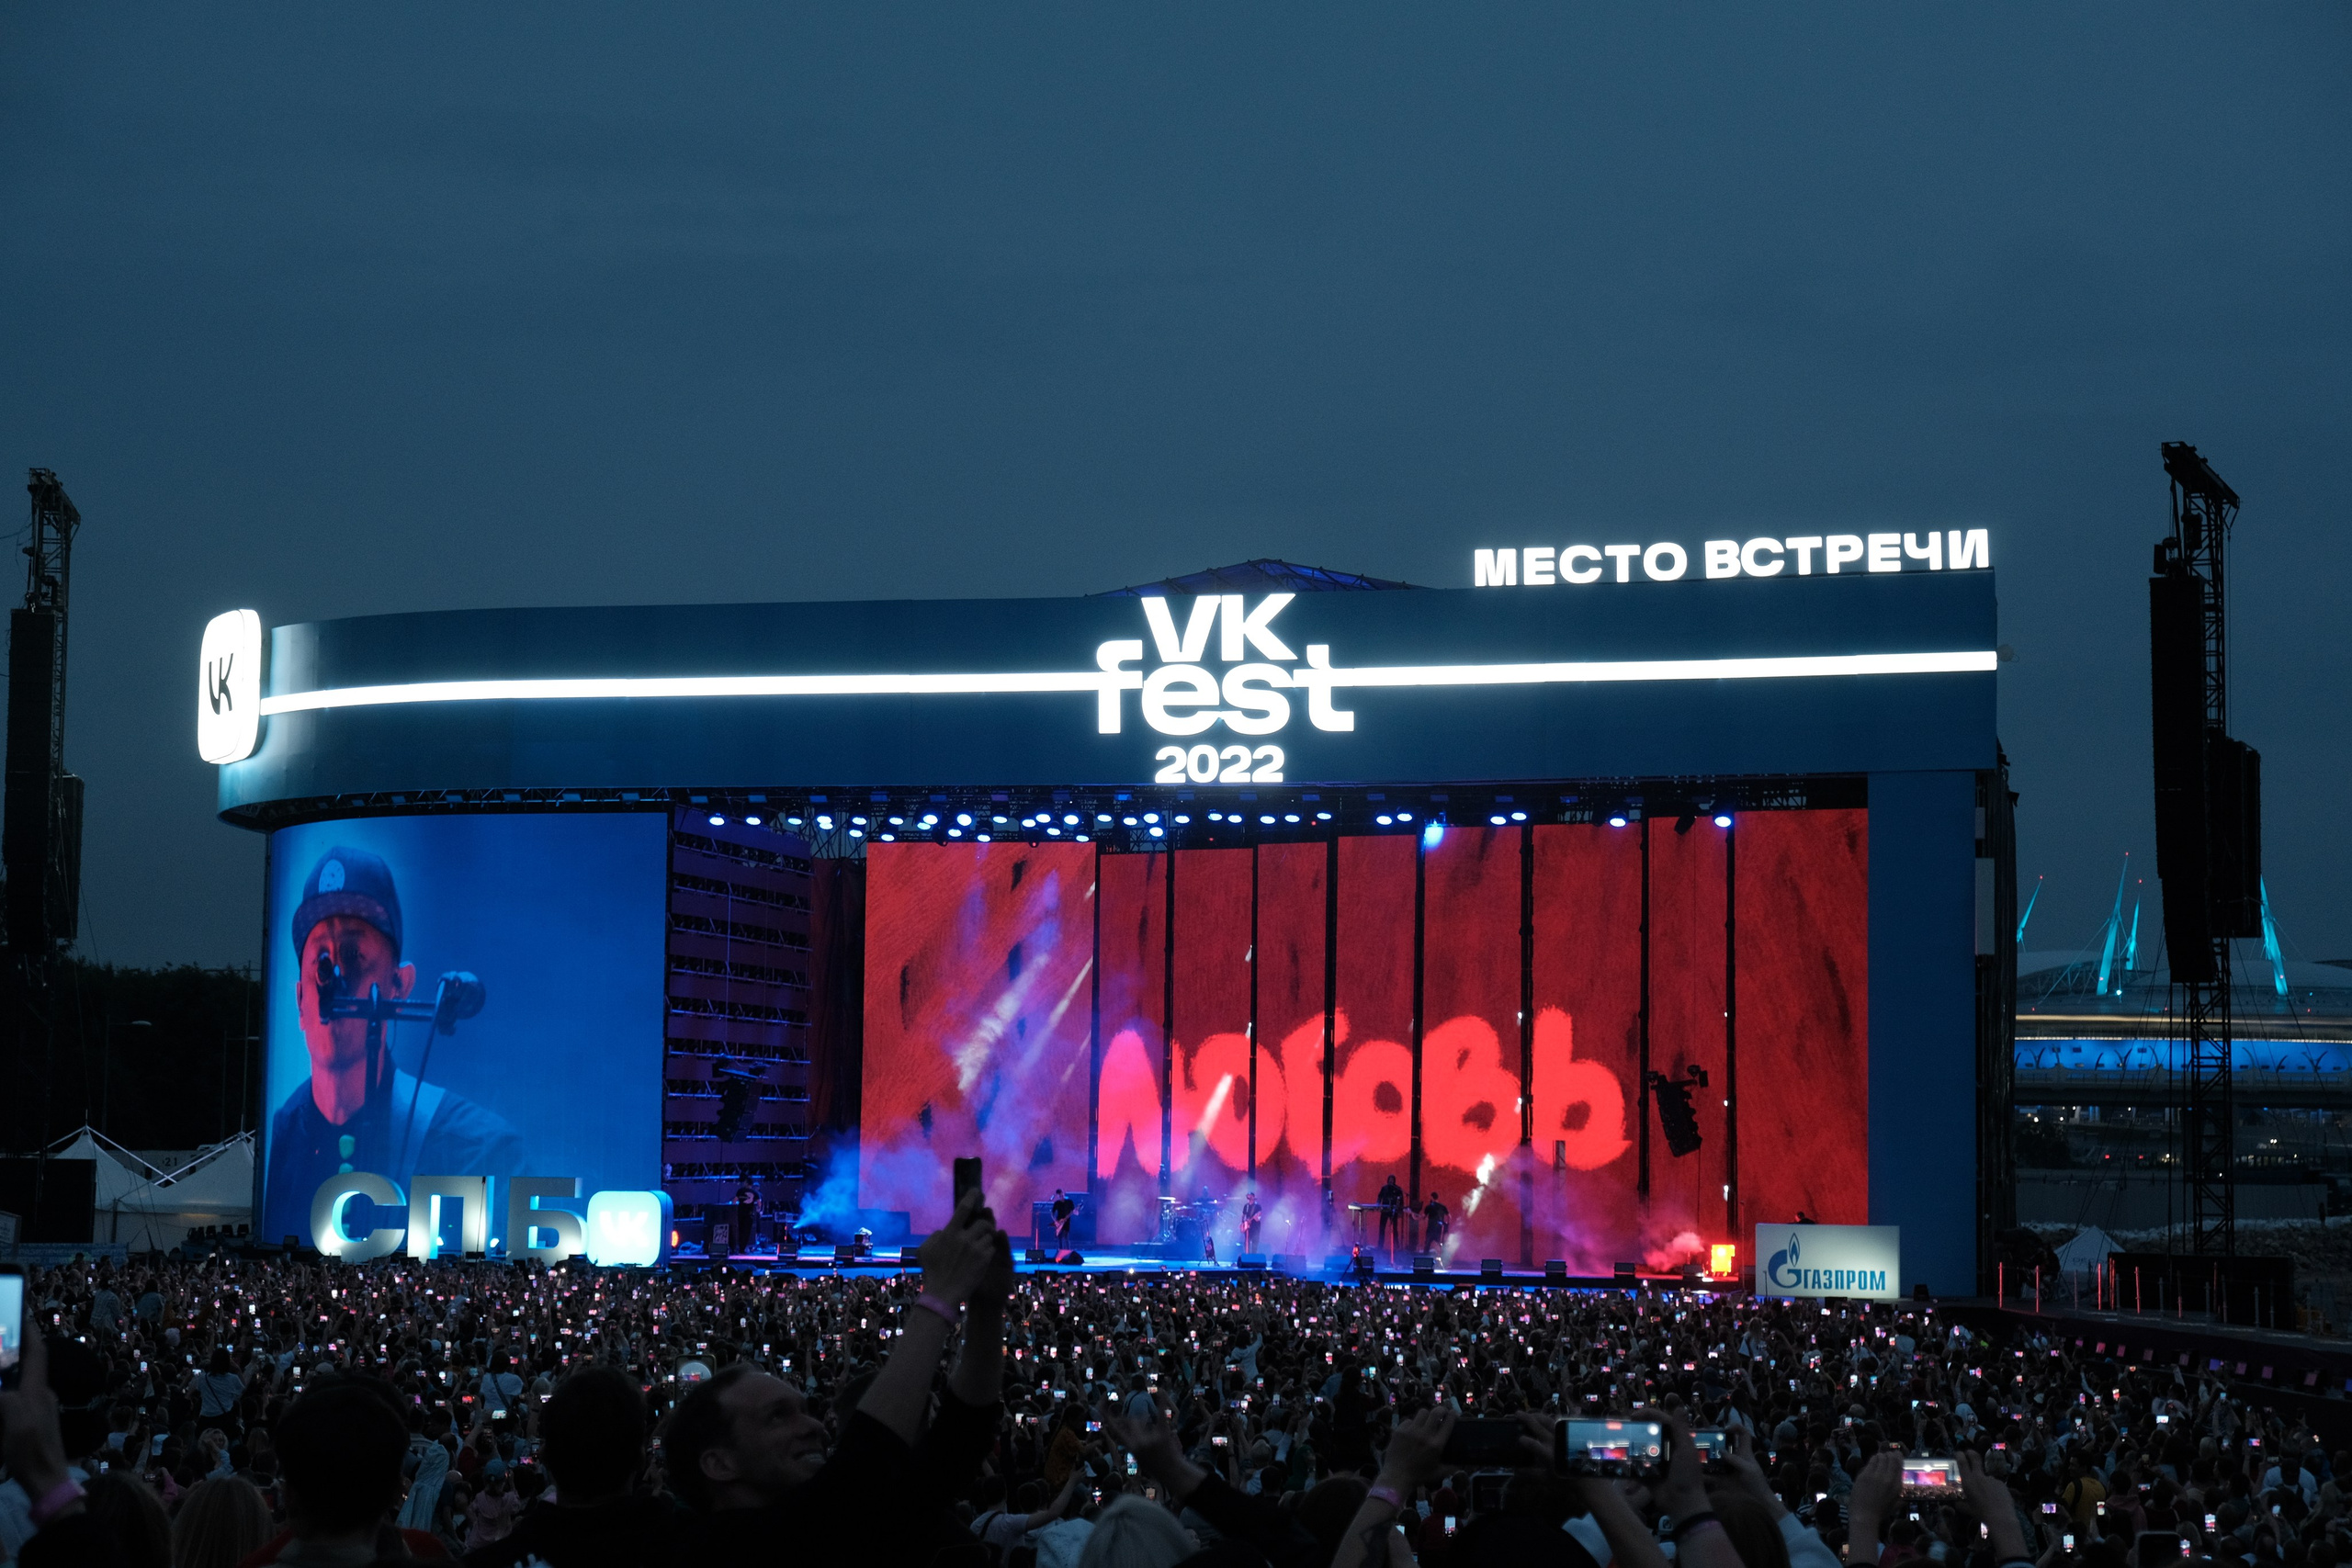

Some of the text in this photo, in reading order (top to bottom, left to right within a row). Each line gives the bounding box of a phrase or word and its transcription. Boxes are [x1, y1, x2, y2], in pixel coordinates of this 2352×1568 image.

[1474, 528, 1990, 587] МЕСТО ВСТРЕЧИ
[1140, 593, 1298, 663] VK
[1096, 639, 1355, 737] fest
[1155, 744, 1285, 784] 2022
[310, 1171, 586, 1267] СПБ
[1804, 1269, 1885, 1291] ГАЗПРОМ
